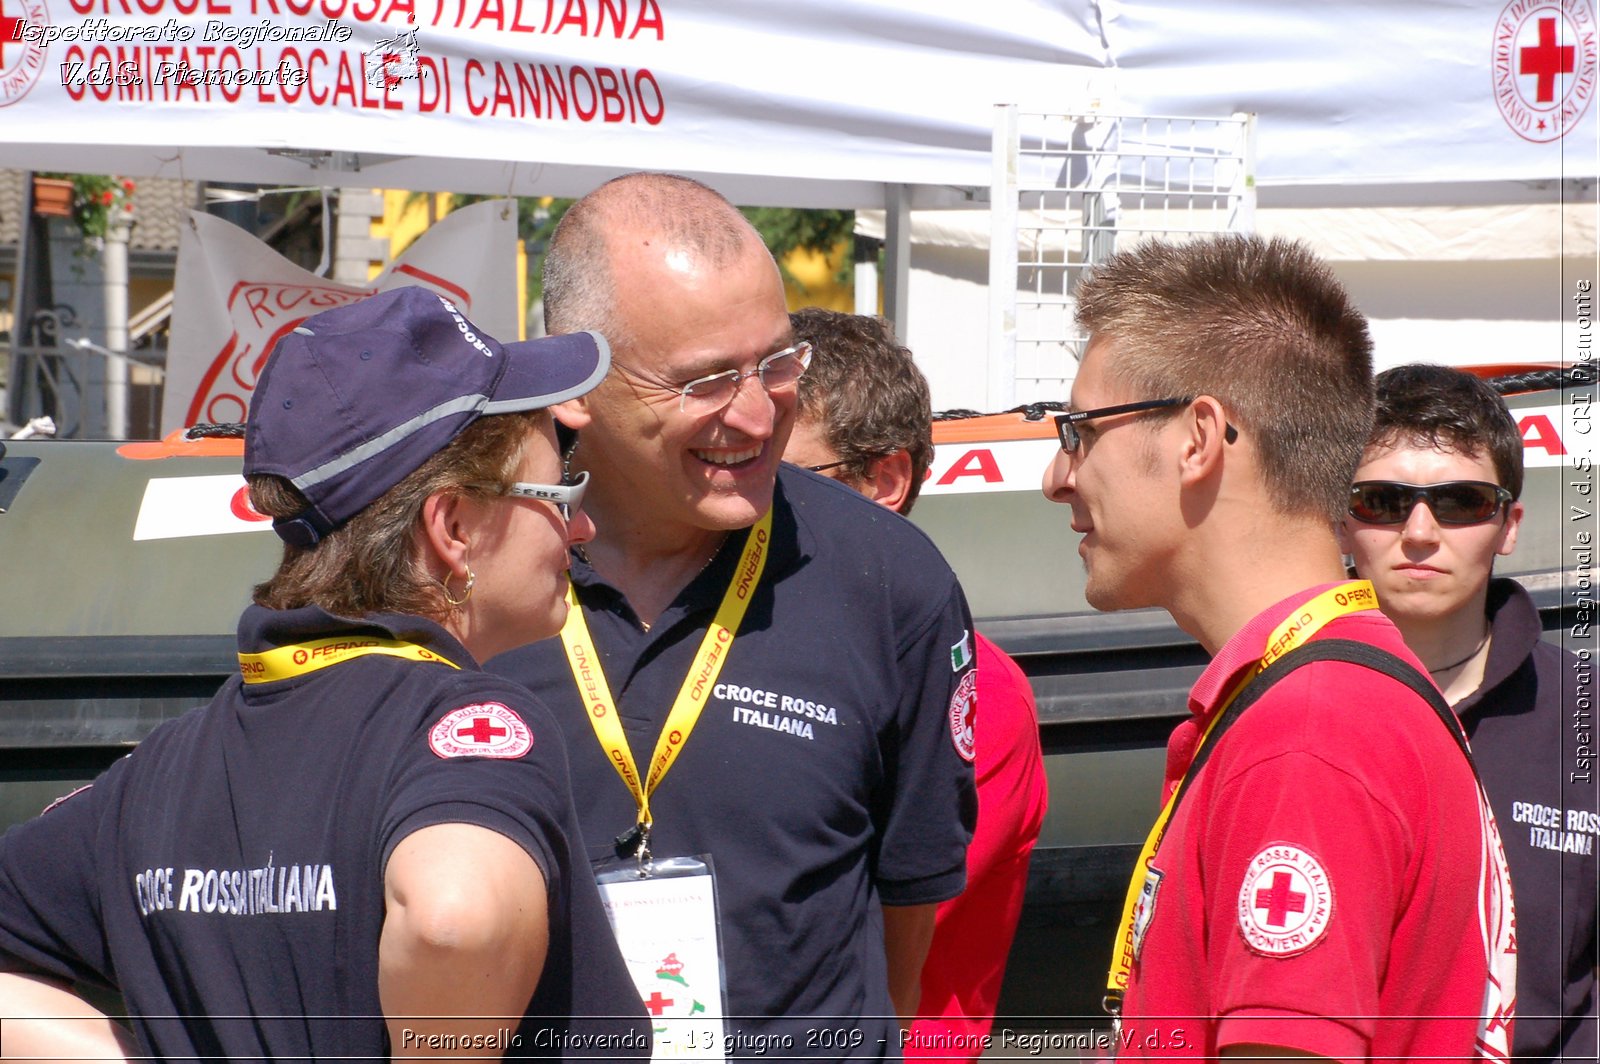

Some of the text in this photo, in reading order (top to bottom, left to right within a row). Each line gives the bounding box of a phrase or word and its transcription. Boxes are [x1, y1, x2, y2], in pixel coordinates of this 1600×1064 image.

[64, 45, 664, 125] COMITATO LOCALE DI CANNOBIO
[736, 543, 763, 600] FERNO
[311, 640, 380, 659] FERNO
[1262, 612, 1313, 666] FERNO
[240, 661, 266, 673] ERNO
[573, 644, 600, 702] FERNO
[690, 643, 723, 702] FERNO
[713, 683, 838, 726] CROCE ROSSA
[733, 706, 814, 740] ITALIANA
[1512, 801, 1562, 828] CROCE
[1530, 827, 1592, 855] ITALIANA
[248, 864, 336, 915] ITALIANA
[1257, 849, 1299, 868] ROSSA
[1303, 860, 1327, 925] ITALIANA
